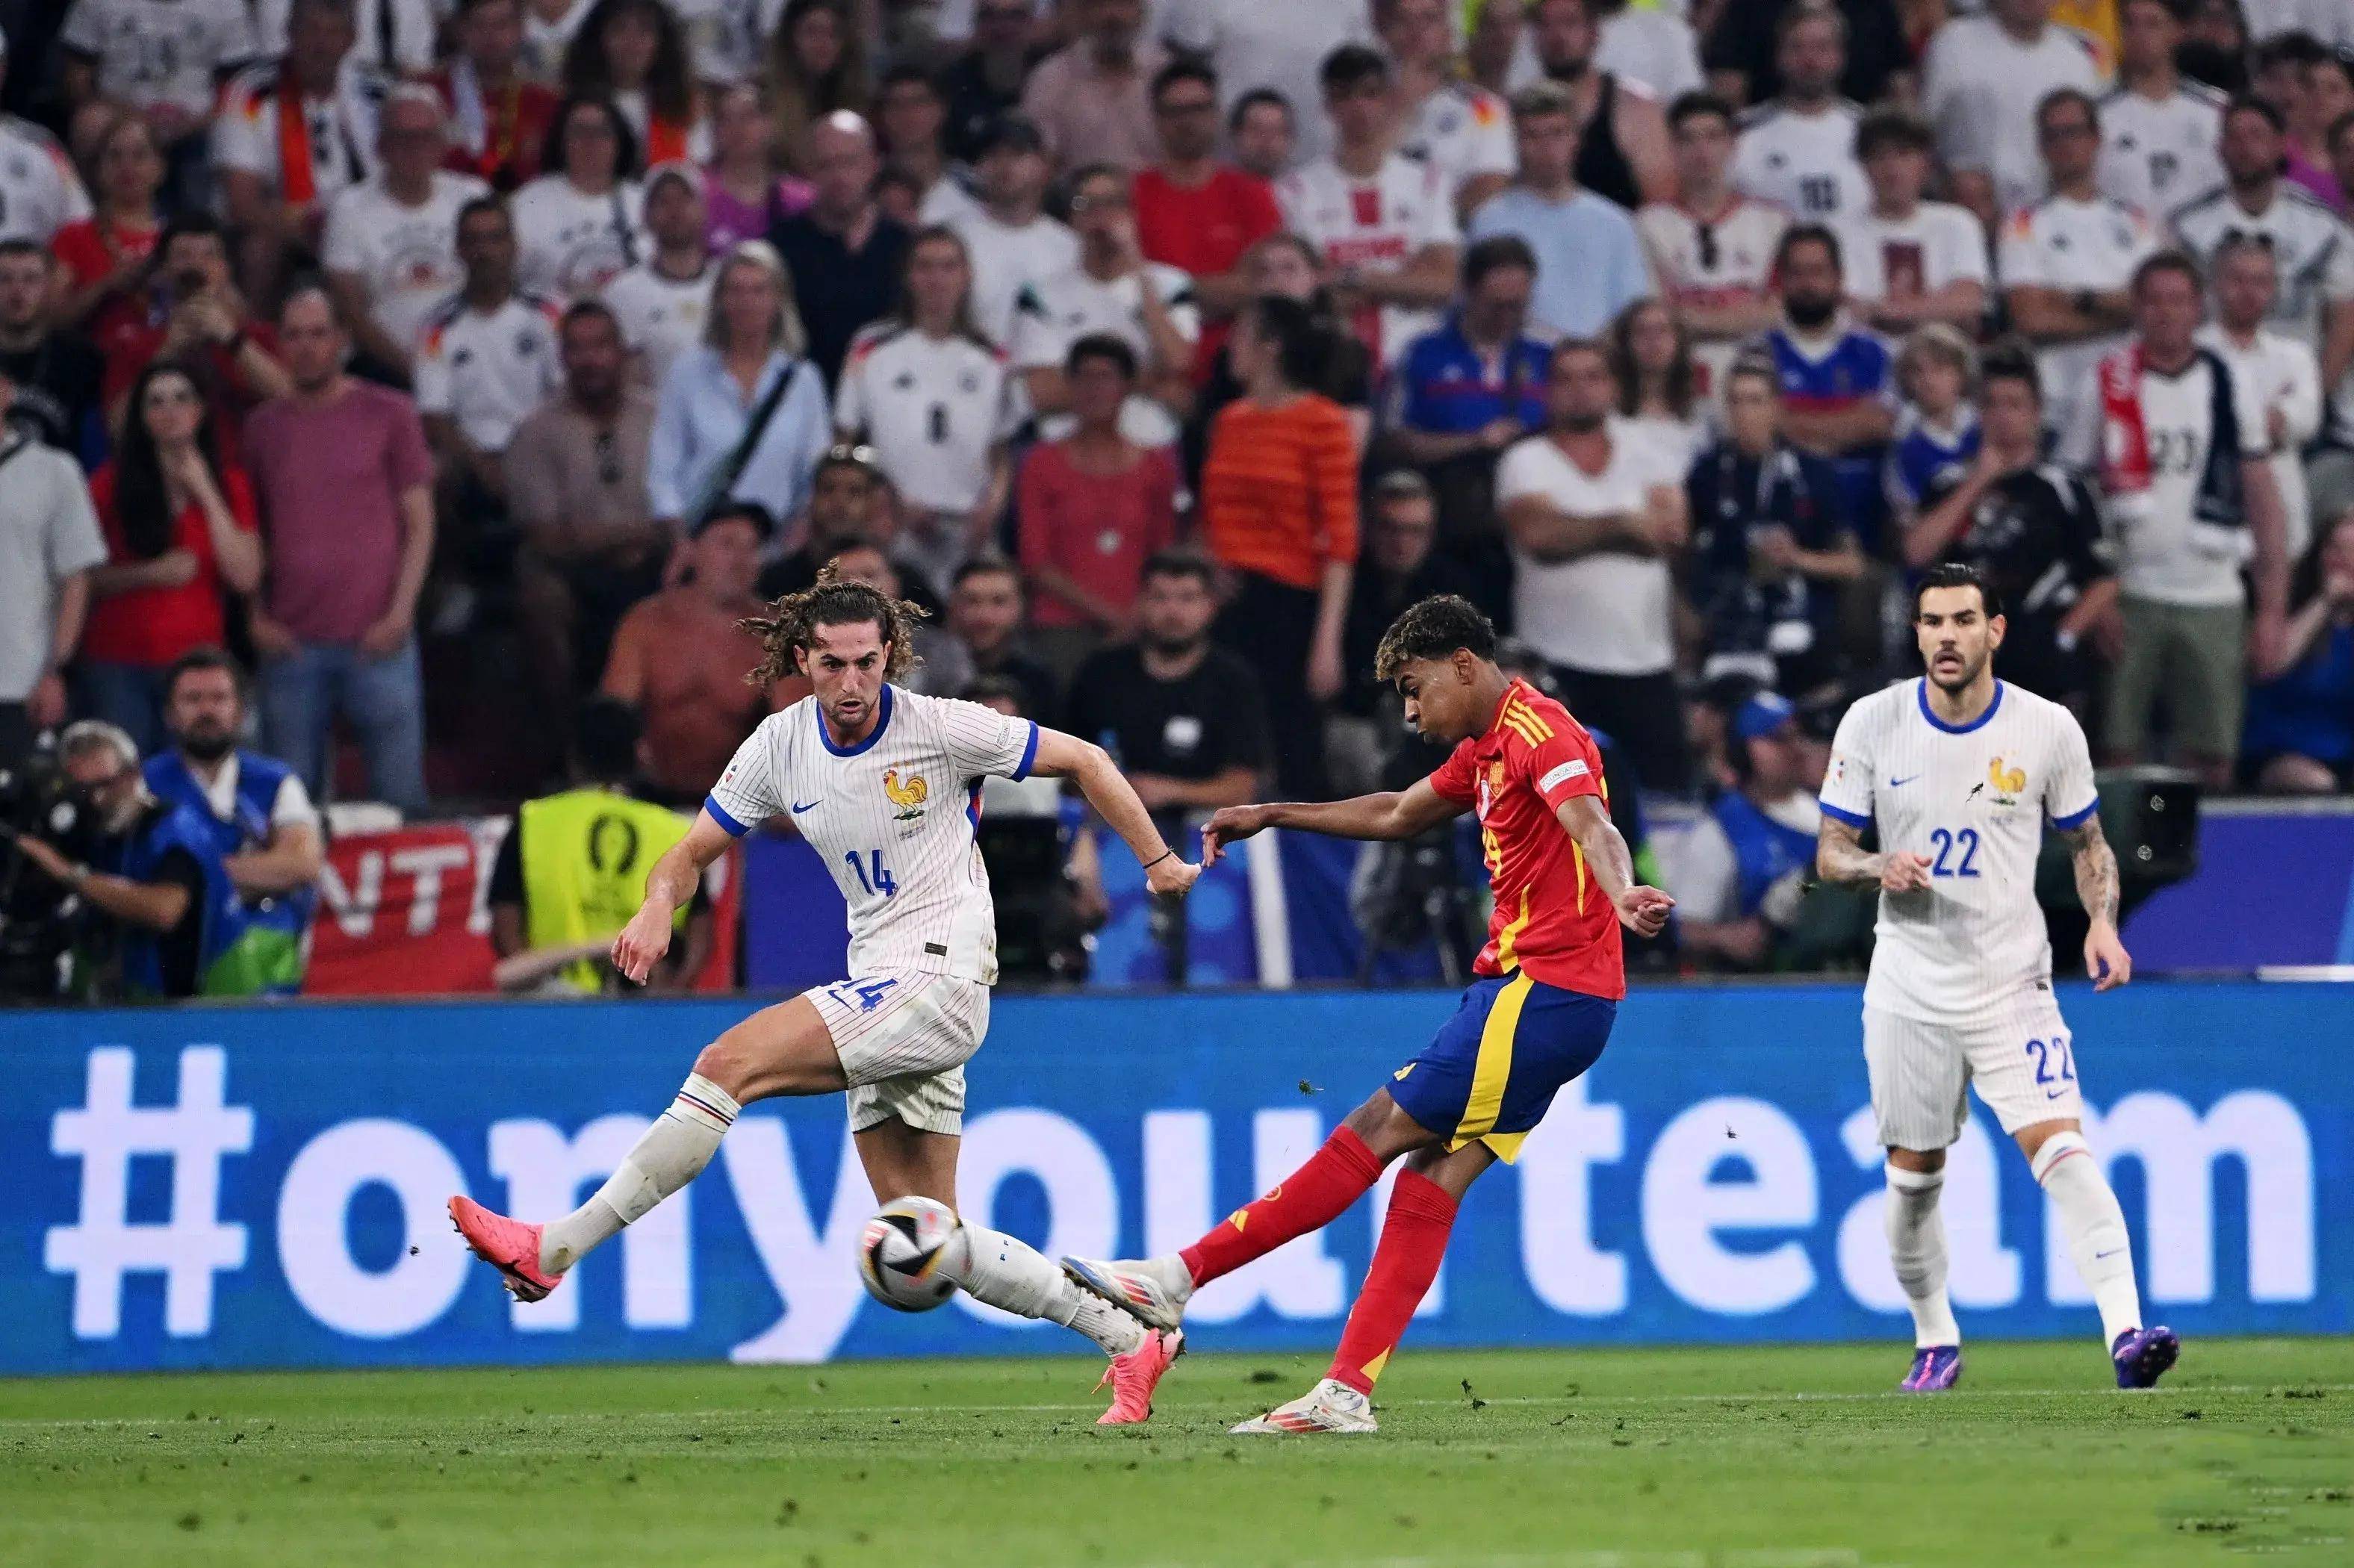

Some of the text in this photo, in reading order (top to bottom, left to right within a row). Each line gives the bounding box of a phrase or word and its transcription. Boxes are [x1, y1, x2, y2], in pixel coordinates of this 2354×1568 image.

[845, 850, 898, 897] 14
[1931, 827, 1981, 877] 22
[2026, 1037, 2074, 1084] 22
